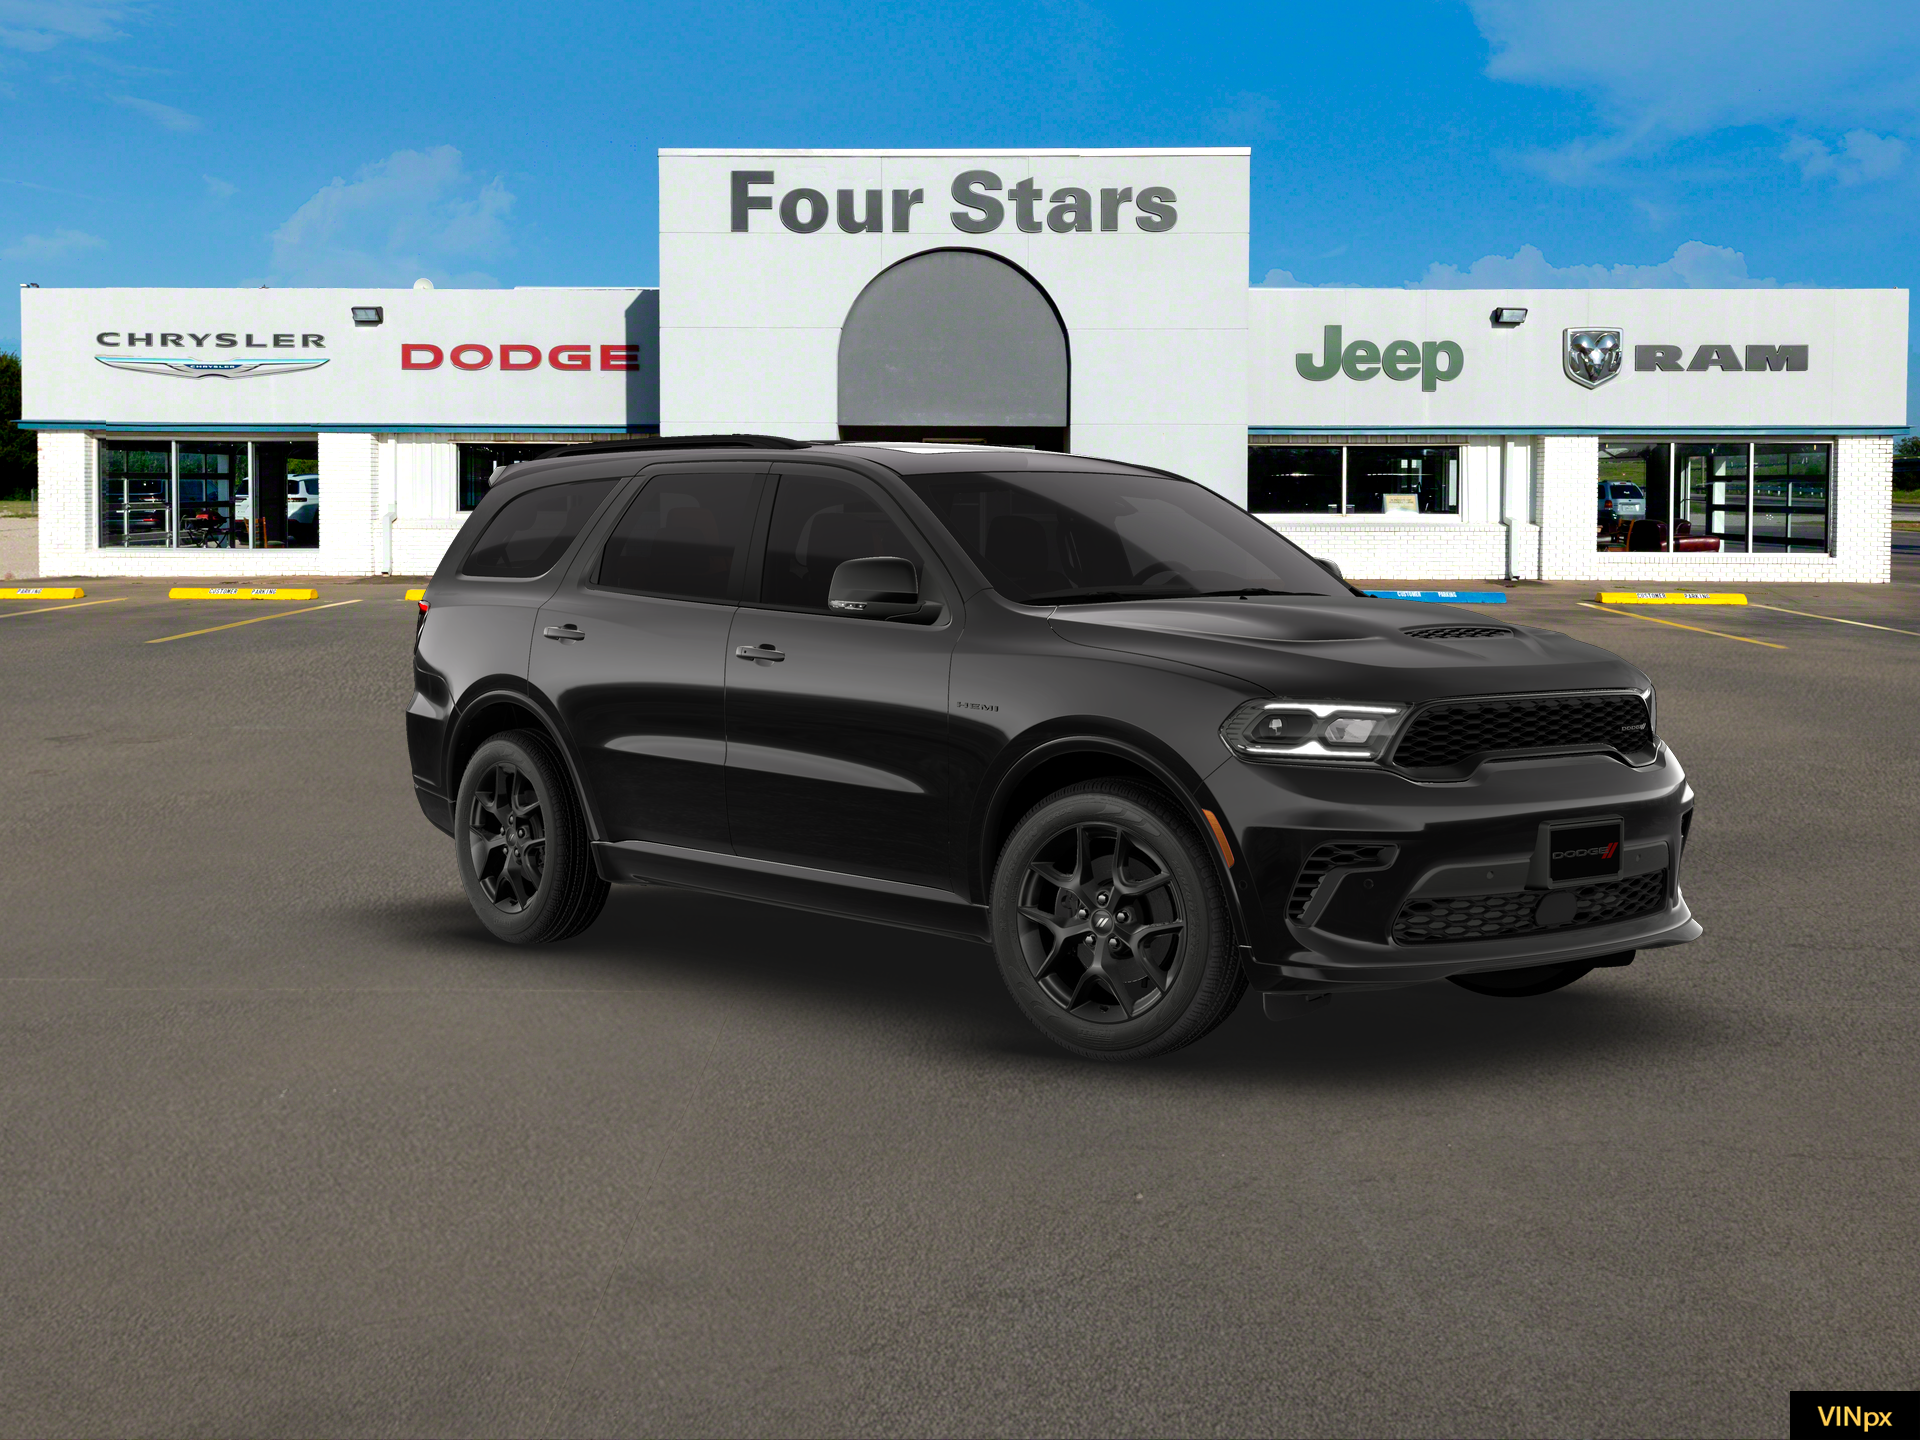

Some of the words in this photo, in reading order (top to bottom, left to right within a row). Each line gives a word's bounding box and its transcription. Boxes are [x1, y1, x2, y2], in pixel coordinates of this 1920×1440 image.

[731, 170, 924, 233] Four
[951, 169, 1178, 233] Stars
[96, 331, 327, 349] CHRYSLER
[401, 343, 640, 371] DODGE
[1295, 325, 1464, 392] Jeep
[1634, 344, 1809, 372] RAM
[956, 701, 999, 713] HEMI
[1552, 846, 1609, 859] DODGE
